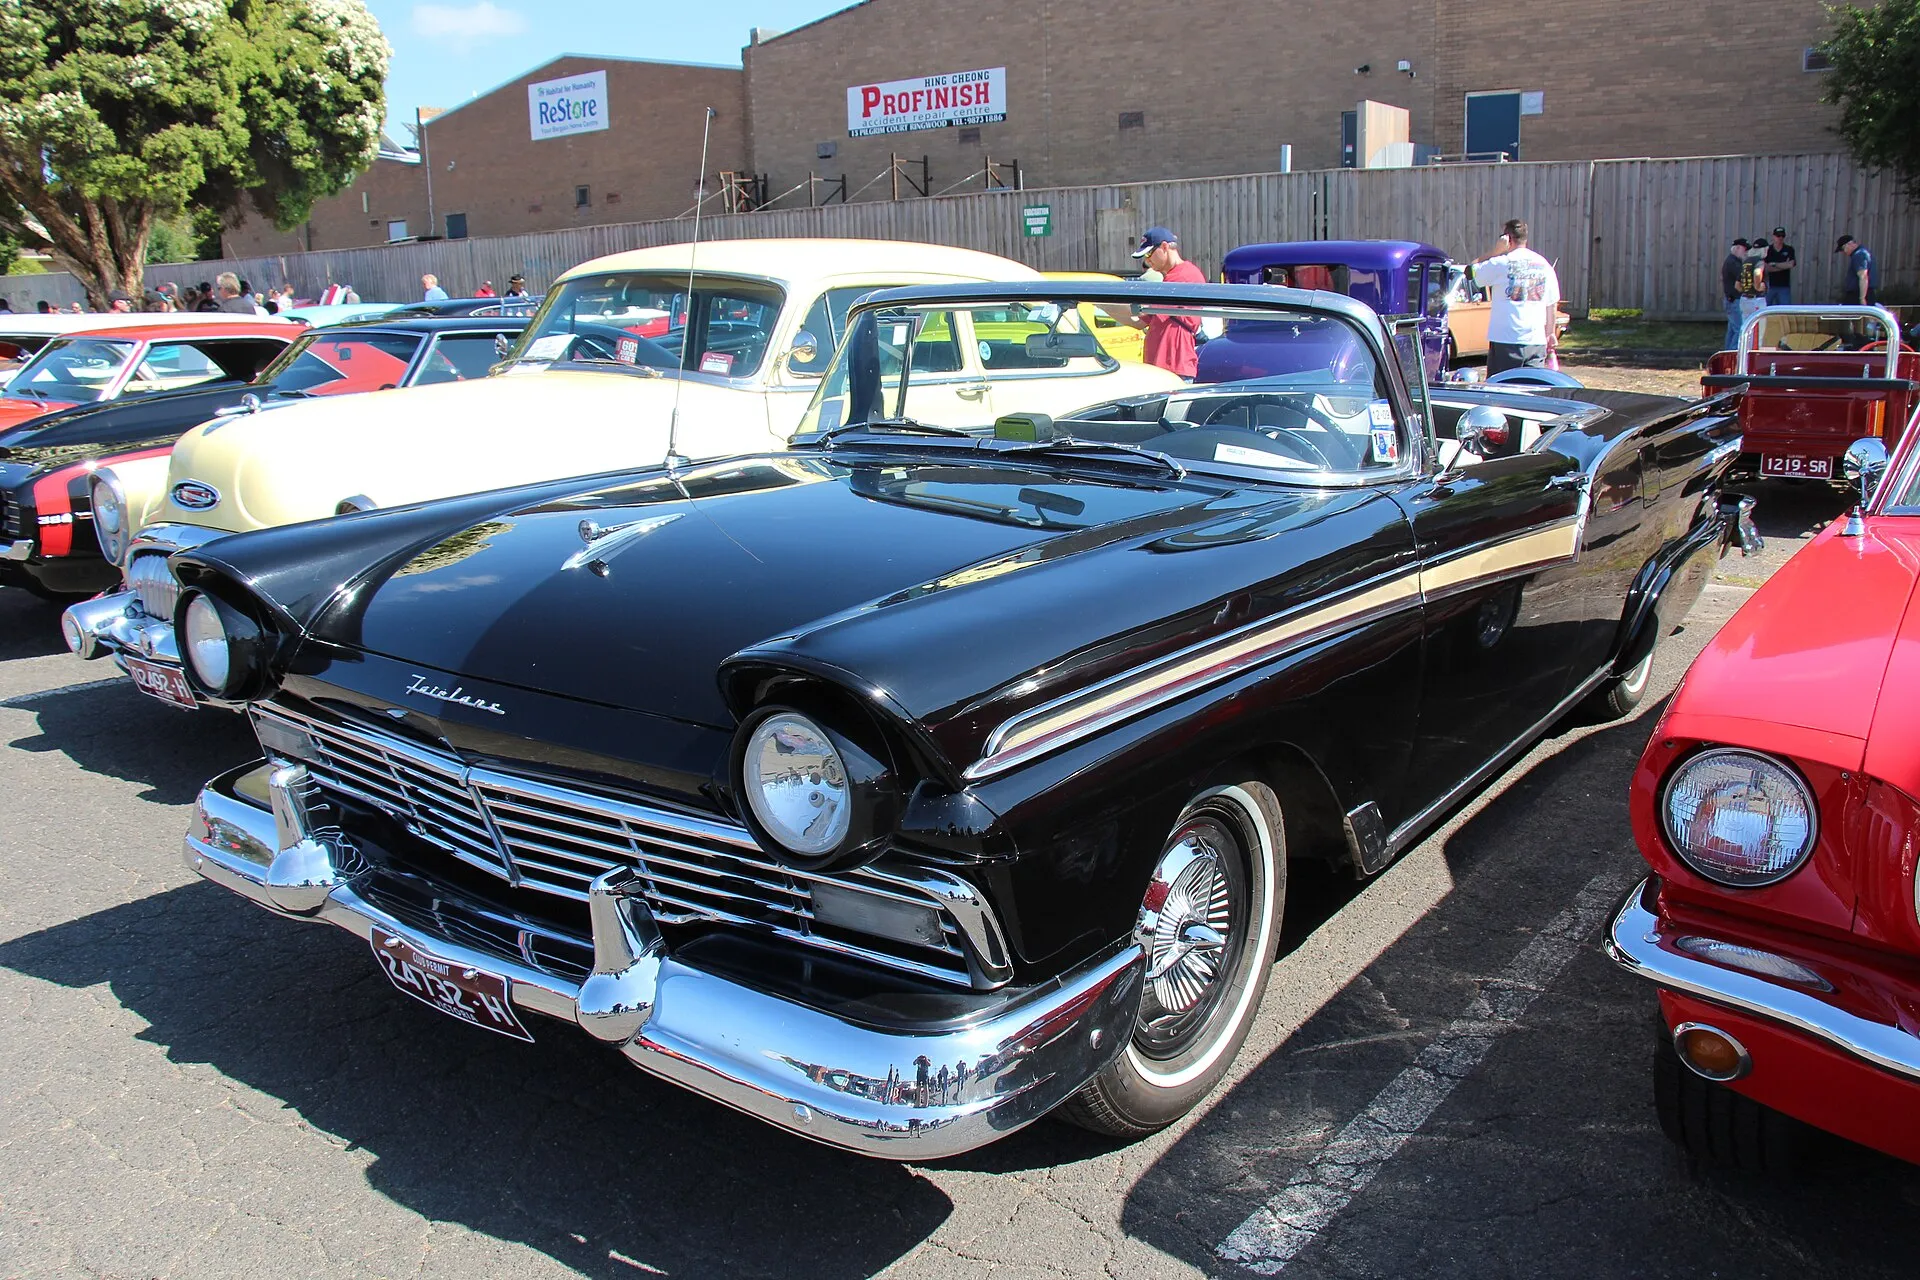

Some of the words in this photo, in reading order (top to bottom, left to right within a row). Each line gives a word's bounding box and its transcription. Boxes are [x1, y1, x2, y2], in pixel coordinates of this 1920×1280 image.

[572, 80, 596, 91] Humanity
[924, 76, 947, 88] HING
[952, 71, 990, 84] CHEONG
[539, 98, 597, 125] ReStore
[862, 114, 907, 127] accident
[913, 110, 946, 122] repair
[953, 106, 990, 117] centre
[860, 126, 886, 137] PILGRIM
[886, 123, 908, 133] COURT
[412, 952, 427, 968] CLUB
[426, 957, 450, 976] PERMIT
[433, 998, 479, 1023] VICTORIA
